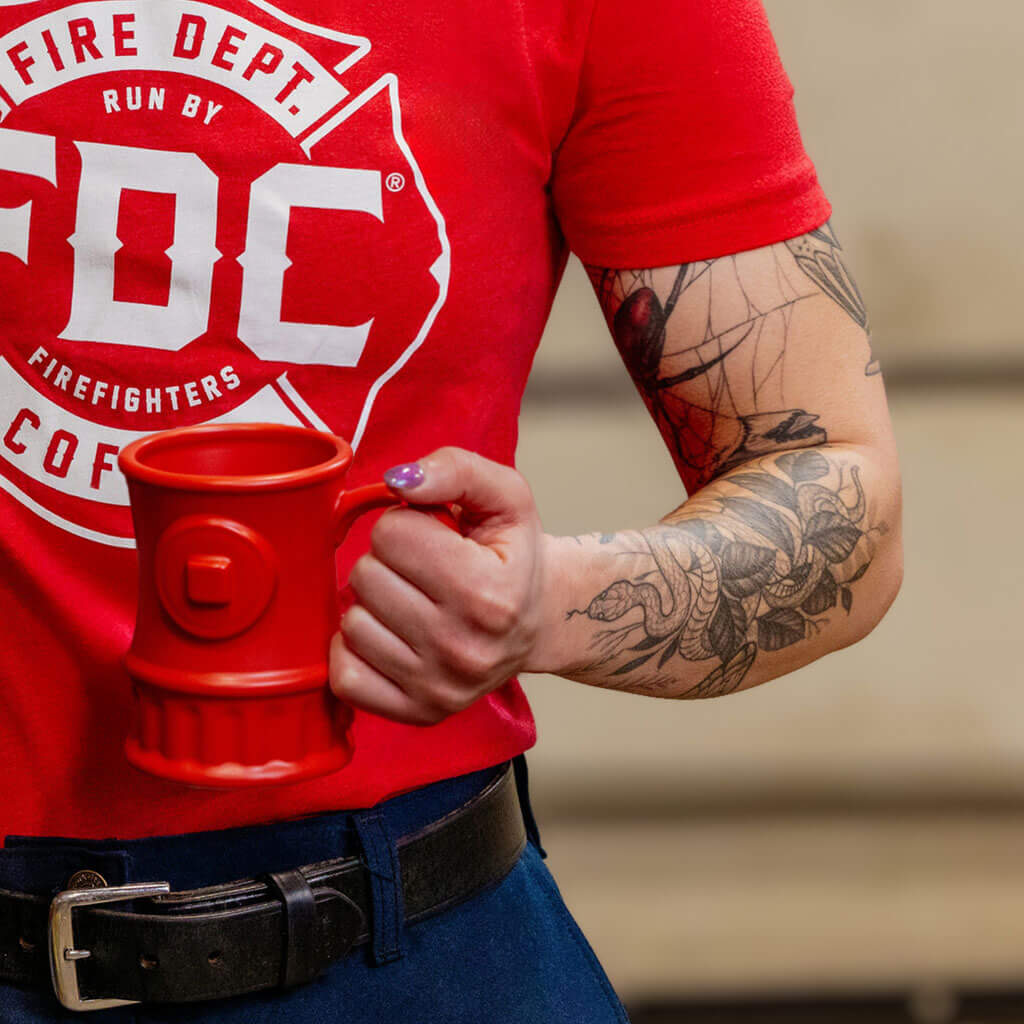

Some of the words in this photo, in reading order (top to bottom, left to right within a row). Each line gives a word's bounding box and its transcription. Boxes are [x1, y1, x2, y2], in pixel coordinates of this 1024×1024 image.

[6, 12, 138, 86] FIRE
[172, 12, 316, 116] DEPT.
[102, 86, 166, 114] RUN
[181, 93, 224, 126] BY
[28, 345, 241, 414] FIREFIGHTERS
[2, 406, 121, 490] COF
